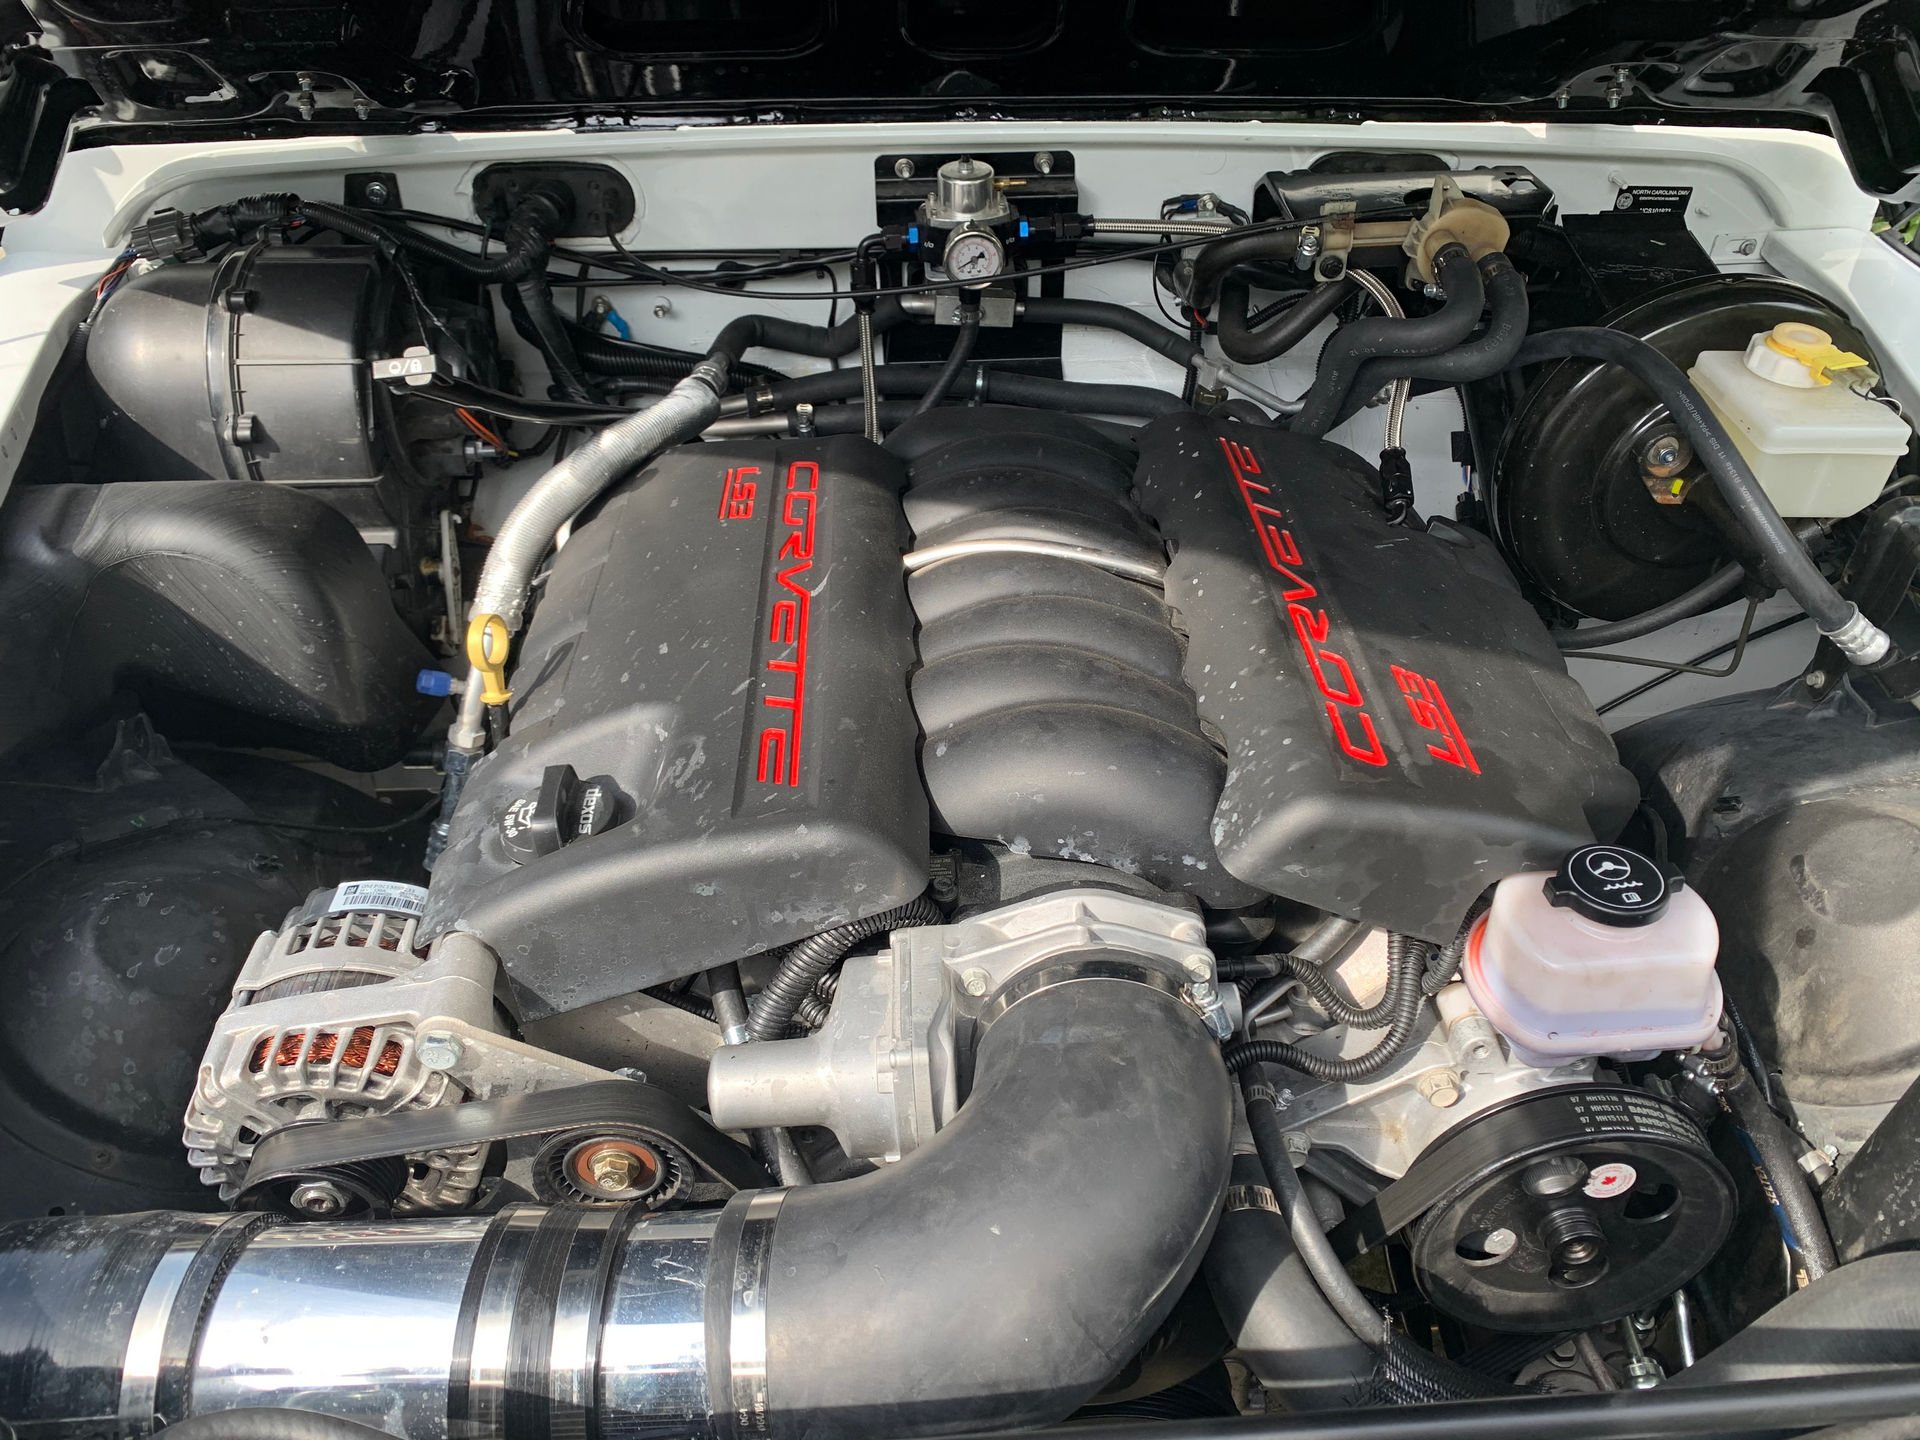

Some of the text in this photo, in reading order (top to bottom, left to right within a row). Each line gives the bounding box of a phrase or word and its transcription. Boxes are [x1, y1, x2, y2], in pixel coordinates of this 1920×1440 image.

[728, 466, 760, 519] LS3
[756, 461, 819, 787] CORVETTE
[1218, 436, 1389, 767] CORVETTE
[1390, 664, 1467, 769] LS3
[578, 784, 603, 836] dexos
[1627, 1105, 1665, 1119] BANDO
[1632, 1115, 1671, 1129] BANDO
